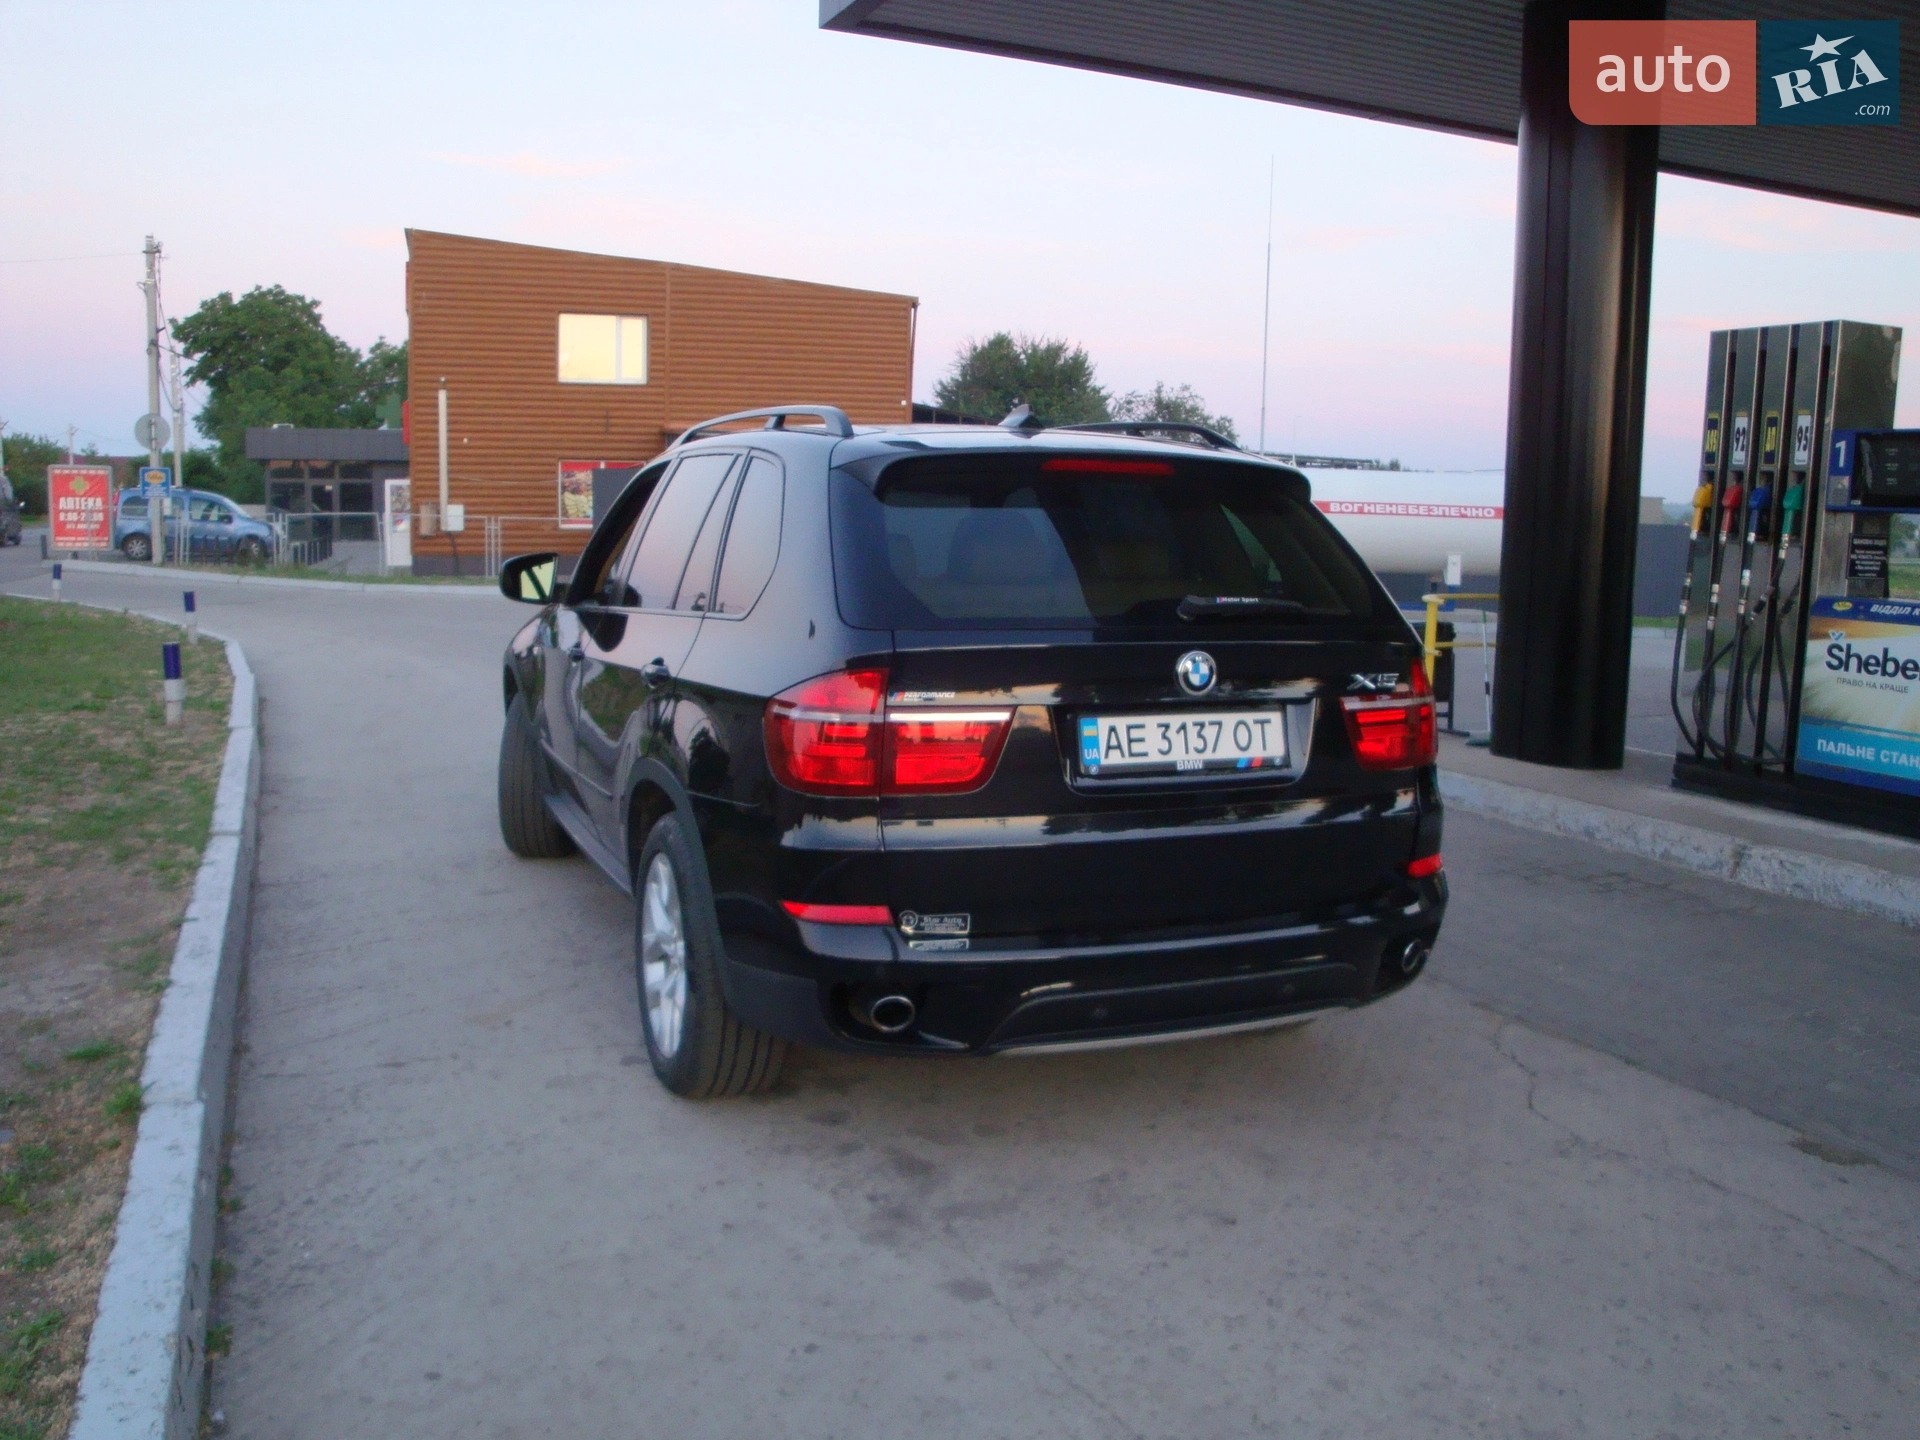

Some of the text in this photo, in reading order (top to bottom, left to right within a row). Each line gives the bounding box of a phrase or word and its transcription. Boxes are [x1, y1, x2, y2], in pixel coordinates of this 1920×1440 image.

[1734, 426, 1746, 452] 92
[1796, 425, 1809, 452] 95
[1835, 440, 1847, 468] 1
[1329, 502, 1496, 518] ВОГНЕНЕБЕЗПЕЧНО
[1869, 604, 1912, 615] ВІДДІЛ
[1346, 672, 1400, 690] X5
[1836, 677, 1909, 694] ПРАВО НА КРАЩЕ
[903, 690, 956, 698] PERFORMANCE
[1103, 717, 1272, 760] AE 3137 OT
[1084, 747, 1100, 760] UA
[1817, 738, 1920, 770] ПАЛЬНЕ СТАН
[1176, 759, 1203, 771] BMW
